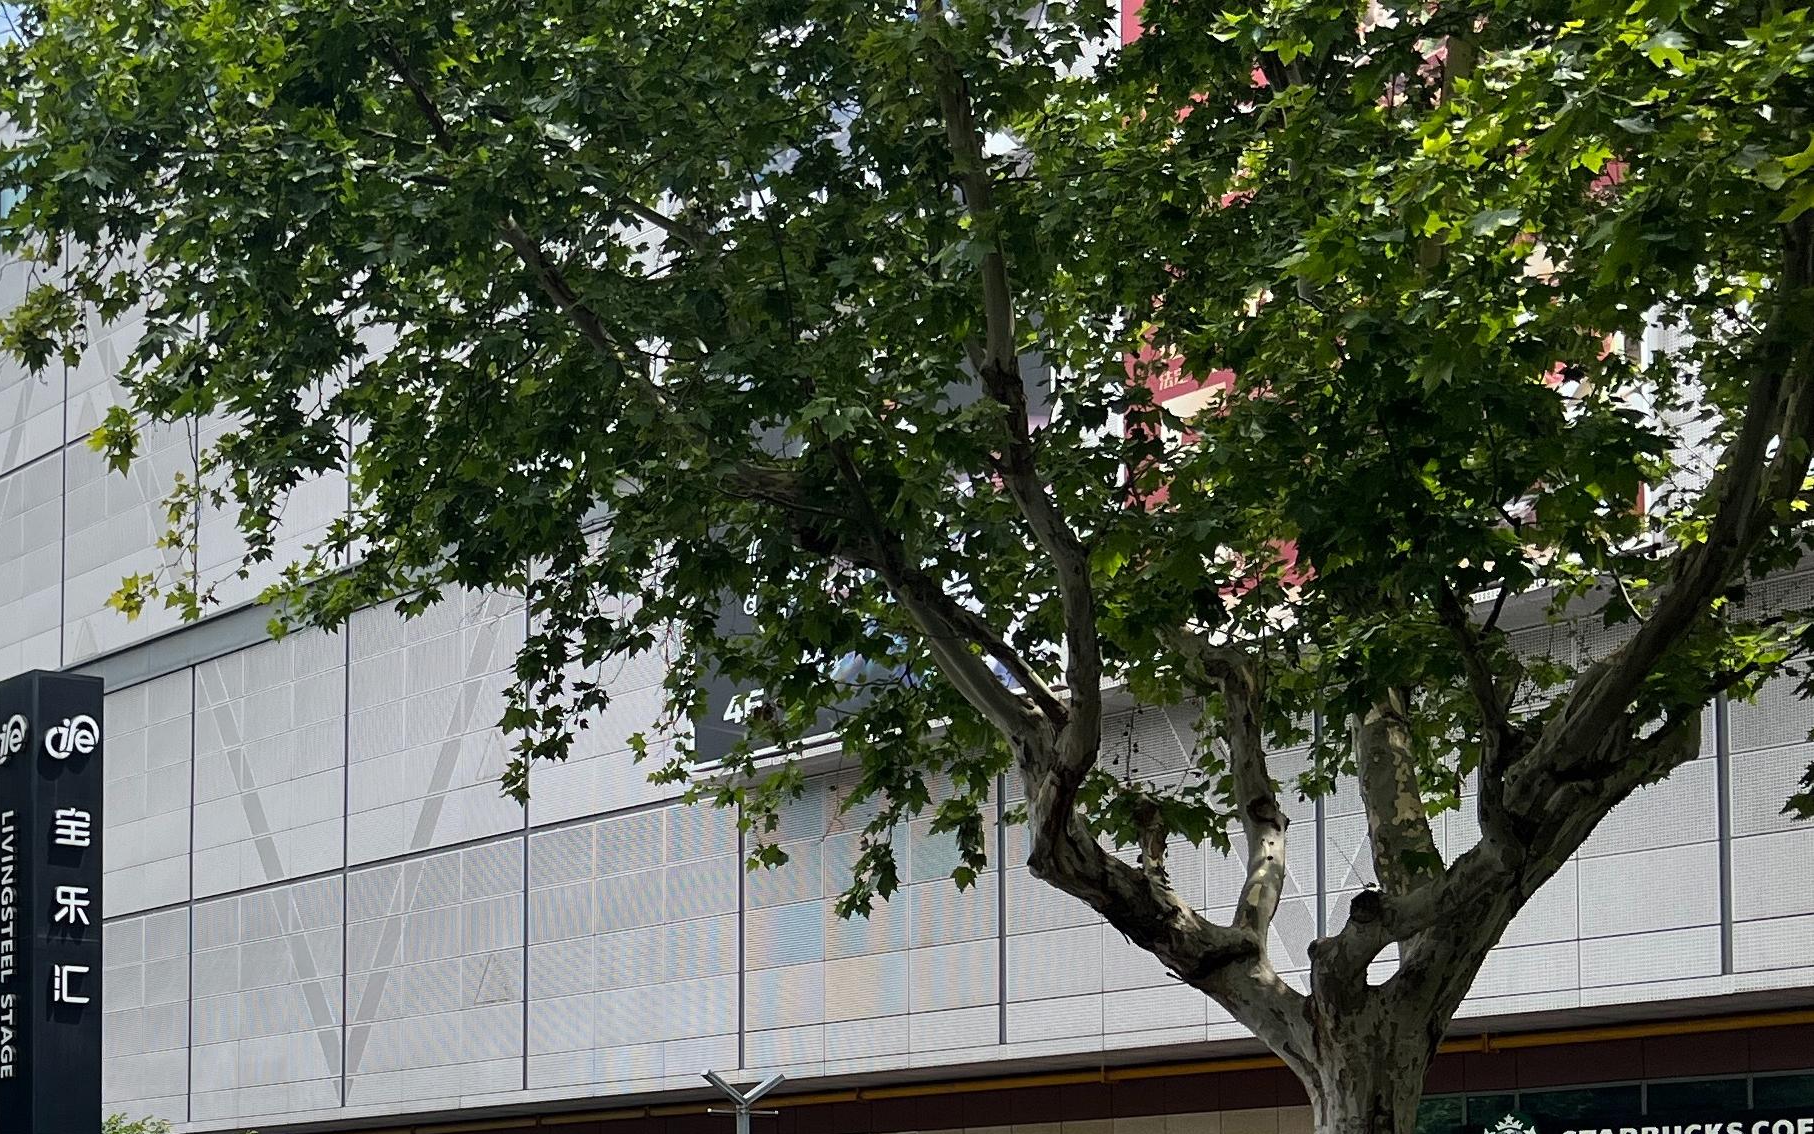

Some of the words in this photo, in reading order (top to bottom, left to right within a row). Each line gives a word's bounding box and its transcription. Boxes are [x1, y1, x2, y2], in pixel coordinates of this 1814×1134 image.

[0, 809, 16, 984] LIVINGSTEEL
[54, 807, 91, 1004] 宝乐汇
[0, 993, 15, 1080] STAGE
